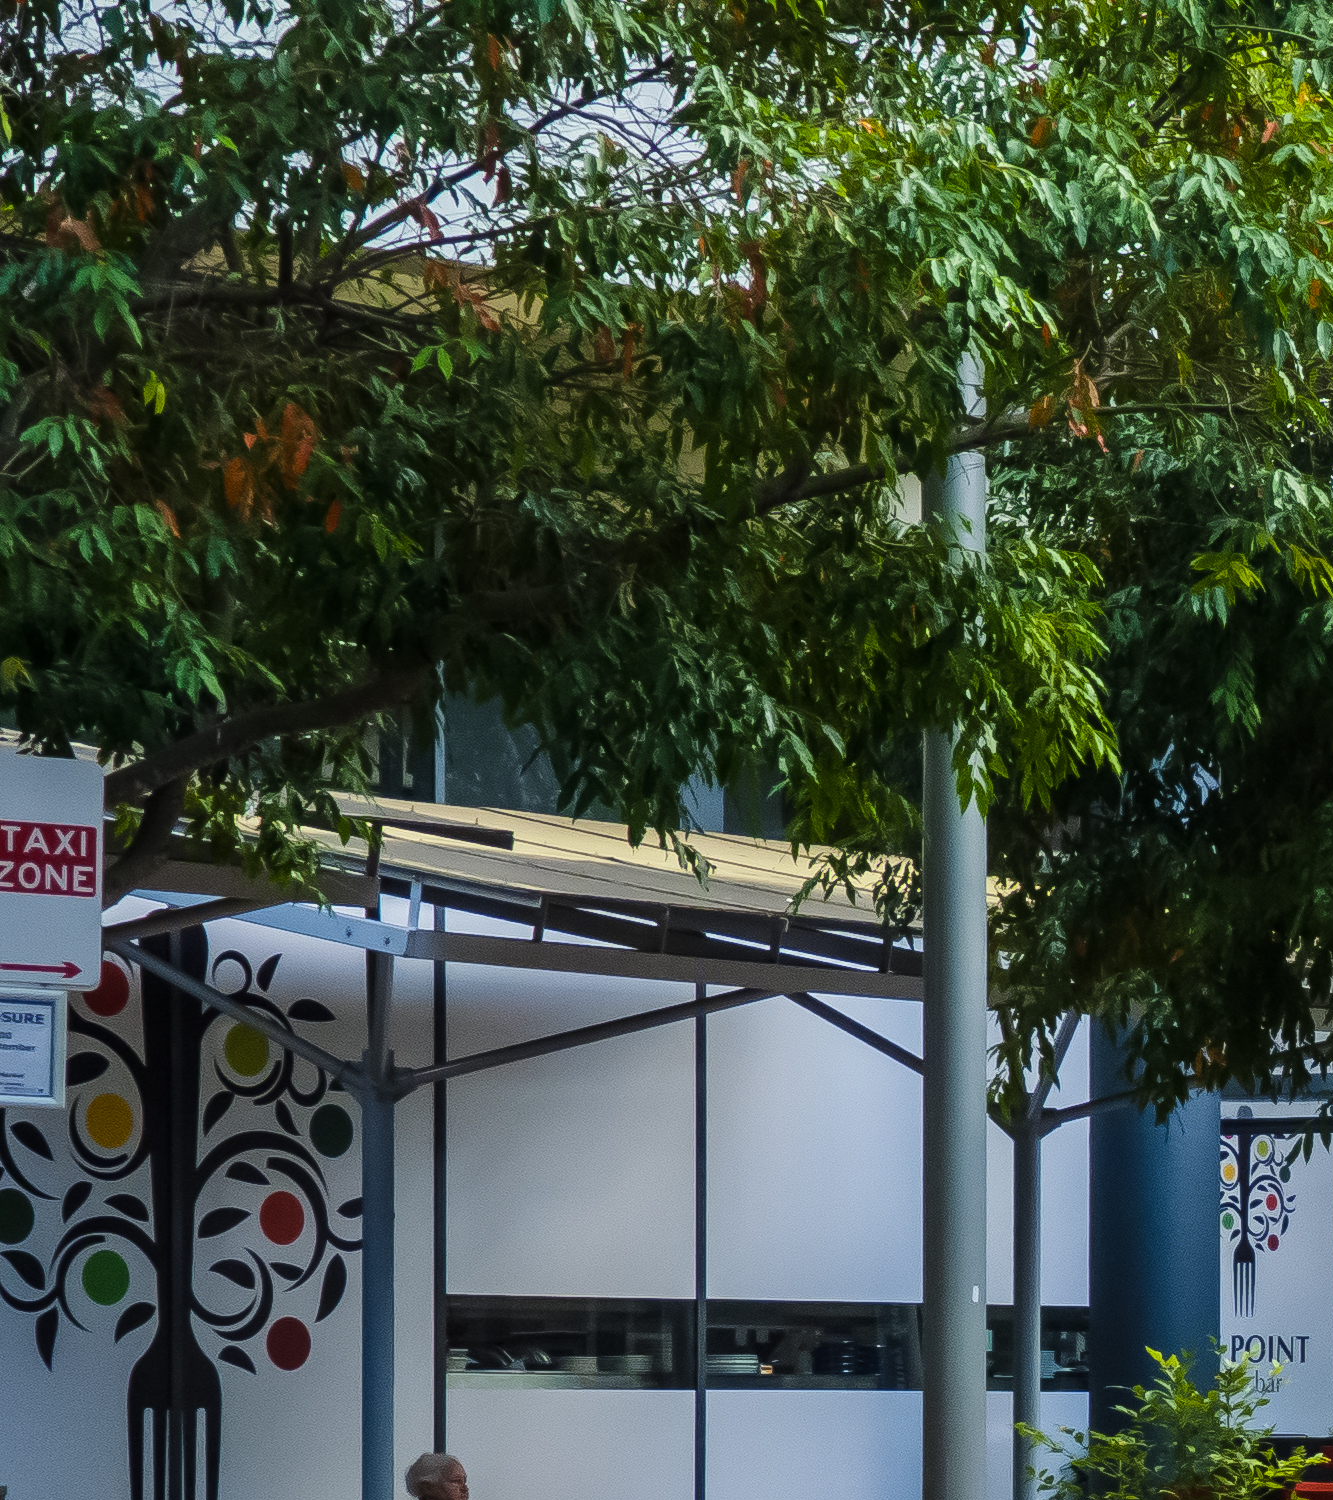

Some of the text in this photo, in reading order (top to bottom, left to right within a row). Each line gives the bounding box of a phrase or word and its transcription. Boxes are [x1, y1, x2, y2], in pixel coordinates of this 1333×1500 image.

[1, 825, 87, 857] TAXI
[0, 861, 94, 893] ZONE
[0, 1011, 45, 1025] SURE
[1231, 1334, 1310, 1363] POINT
[1255, 1370, 1282, 1393] bar
